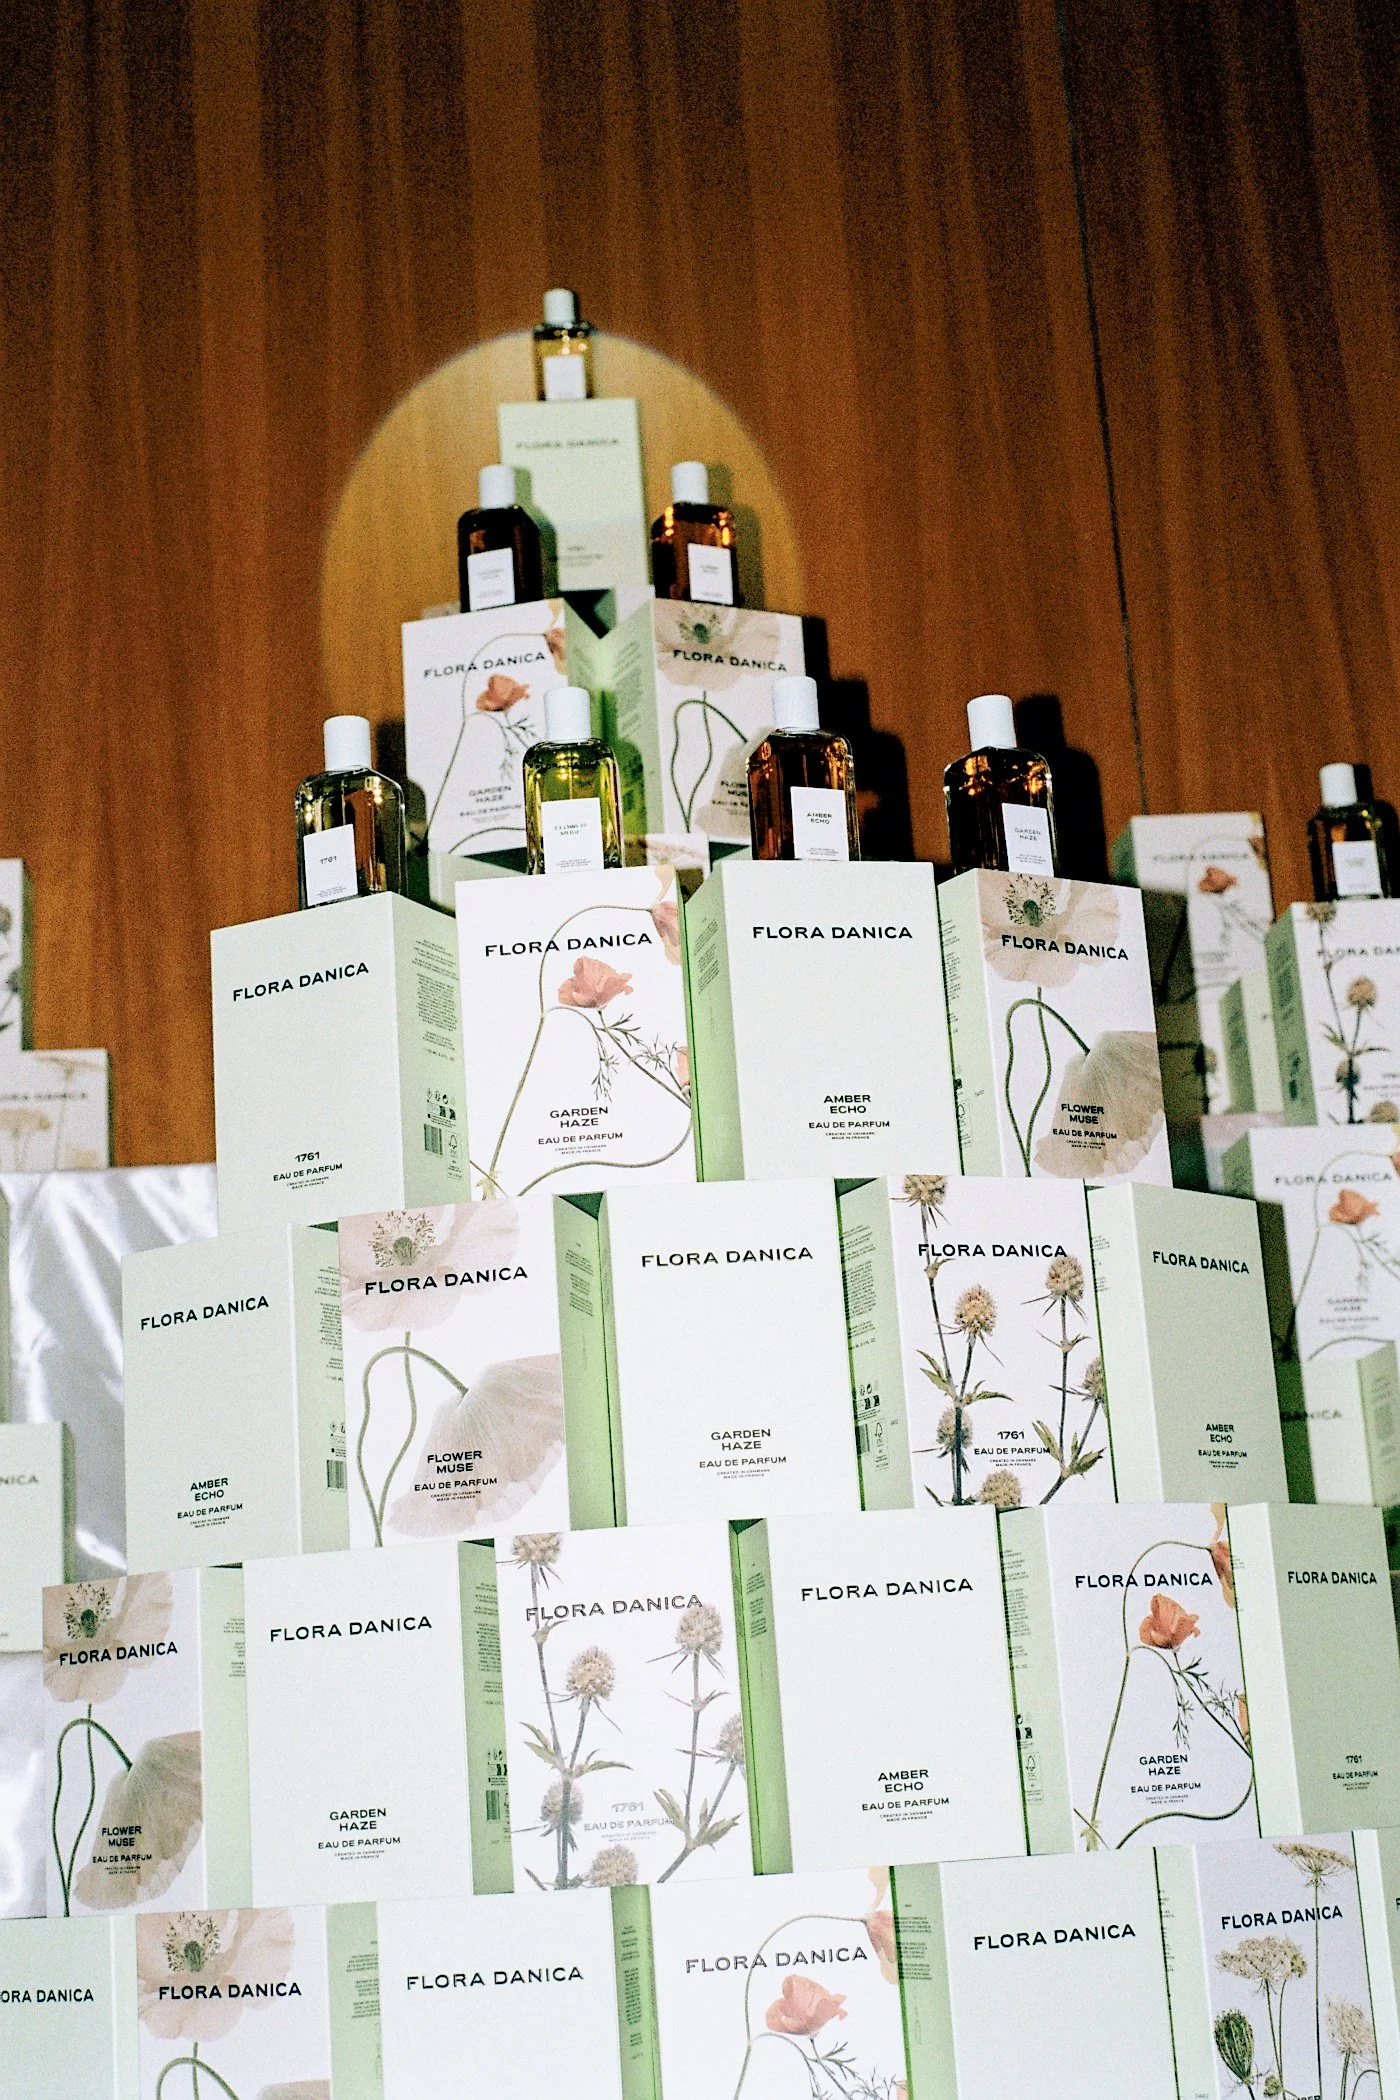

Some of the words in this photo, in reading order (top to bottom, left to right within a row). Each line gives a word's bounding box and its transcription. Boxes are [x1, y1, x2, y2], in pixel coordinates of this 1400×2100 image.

[423, 661, 477, 677] FLORA
[483, 651, 545, 669] DANICA
[672, 648, 723, 663] FLORA
[729, 655, 785, 671] DANICA
[752, 926, 824, 938] FLORA
[831, 926, 912, 938] DANICA
[485, 939, 559, 956] FLORA
[567, 933, 652, 950] DANICA
[1001, 934, 1059, 952] FLORA
[1064, 941, 1128, 960] DANICA
[233, 979, 293, 1001] FLORA
[299, 962, 368, 987] DANICA
[823, 1094, 871, 1103] AMBER
[549, 1106, 608, 1118] GARDEN
[829, 1105, 866, 1113] ECHO
[1061, 1103, 1104, 1114] FLOWER
[560, 1117, 598, 1128] HAZE
[1069, 1114, 1098, 1124] MUSE
[538, 1136, 559, 1144] EAU
[579, 1132, 622, 1141] PARFUM
[1083, 1130, 1117, 1139] PARFUM
[295, 1151, 319, 1162] 1761
[273, 1172, 291, 1181] EAU
[293, 1169, 303, 1177] DE
[306, 1163, 342, 1175] PARFUM
[1274, 1173, 1326, 1186] FLORA
[1332, 1172, 1392, 1183] DANICA
[918, 1243, 985, 1256] FLORA
[992, 1244, 1067, 1257] DANICA
[641, 1252, 718, 1267] FLORA
[726, 1247, 812, 1263] DANICA
[1152, 1251, 1196, 1267] FLORA
[1200, 1256, 1249, 1273] DANICA
[365, 1275, 437, 1295] FLORA
[444, 1266, 527, 1286] DANICA
[140, 1309, 197, 1330] FLORA
[203, 1295, 268, 1318] DANICA
[710, 1428, 770, 1440] GARDEN
[1205, 1423, 1234, 1432] AMBER
[997, 1430, 1024, 1439] 1761
[1209, 1433, 1232, 1443] ECHO
[721, 1440, 761, 1451] HAZE
[1010, 1446, 1050, 1454] PARFUM
[427, 1450, 482, 1463] FLOWER
[699, 1460, 721, 1468] EAU
[741, 1456, 786, 1465] PARFUM
[436, 1462, 473, 1473] MUSE
[190, 1477, 228, 1490] AMBER
[414, 1482, 435, 1491] EAU
[438, 1481, 451, 1489] DE
[454, 1477, 497, 1487] PARFUM
[194, 1489, 224, 1501] ECHO
[196, 1508, 206, 1516] DE
[208, 1503, 242, 1513] PARFUM
[1075, 1574, 1138, 1588] FLORA
[1144, 1572, 1212, 1586] DANICA
[1287, 1571, 1328, 1583] FLORA
[1331, 1571, 1377, 1584] DANICA
[801, 1584, 878, 1601] FLORA
[886, 1578, 973, 1595] DANICA
[525, 1602, 604, 1621] FLORA
[612, 1594, 702, 1614] DANICA
[270, 1624, 341, 1642] FLORA
[349, 1616, 431, 1635] DANICA
[59, 1648, 111, 1666] FLORA
[116, 1641, 177, 1659] DANICA
[1139, 1754, 1187, 1765] GARDEN
[1345, 1754, 1362, 1763] 1761
[877, 1769, 928, 1781] AMBER
[1148, 1766, 1180, 1775] HAZE
[884, 1781, 923, 1792] ECHO
[1130, 1785, 1149, 1793] EAU
[1165, 1782, 1200, 1790] PARFUM
[611, 1801, 643, 1812] 1761
[861, 1802, 884, 1811] EAU
[904, 1797, 949, 1807] PARFUM
[329, 1807, 386, 1820] GARDEN
[101, 1825, 141, 1835] FLOWER
[339, 1820, 376, 1831] HAZE
[583, 1822, 607, 1830] EAU
[609, 1819, 624, 1829] DE
[108, 1837, 135, 1847] MUSE
[318, 1841, 339, 1849] EAU
[341, 1839, 354, 1847] DE
[357, 1836, 400, 1845] PARFUM
[1221, 1911, 1277, 1929] FLORA
[1281, 1904, 1342, 1923] DANICA
[974, 1931, 1047, 1950] FLORA
[1054, 1923, 1135, 1943] DANICA
[685, 1953, 767, 1973] FLORA
[775, 1946, 867, 1966] DANICA
[407, 1972, 484, 1990] FLORA
[493, 1966, 582, 1984] DANICA
[36, 1988, 93, 2002] DANICA
[159, 1985, 221, 2000] FLORA
[228, 1982, 301, 1997] DANICA
